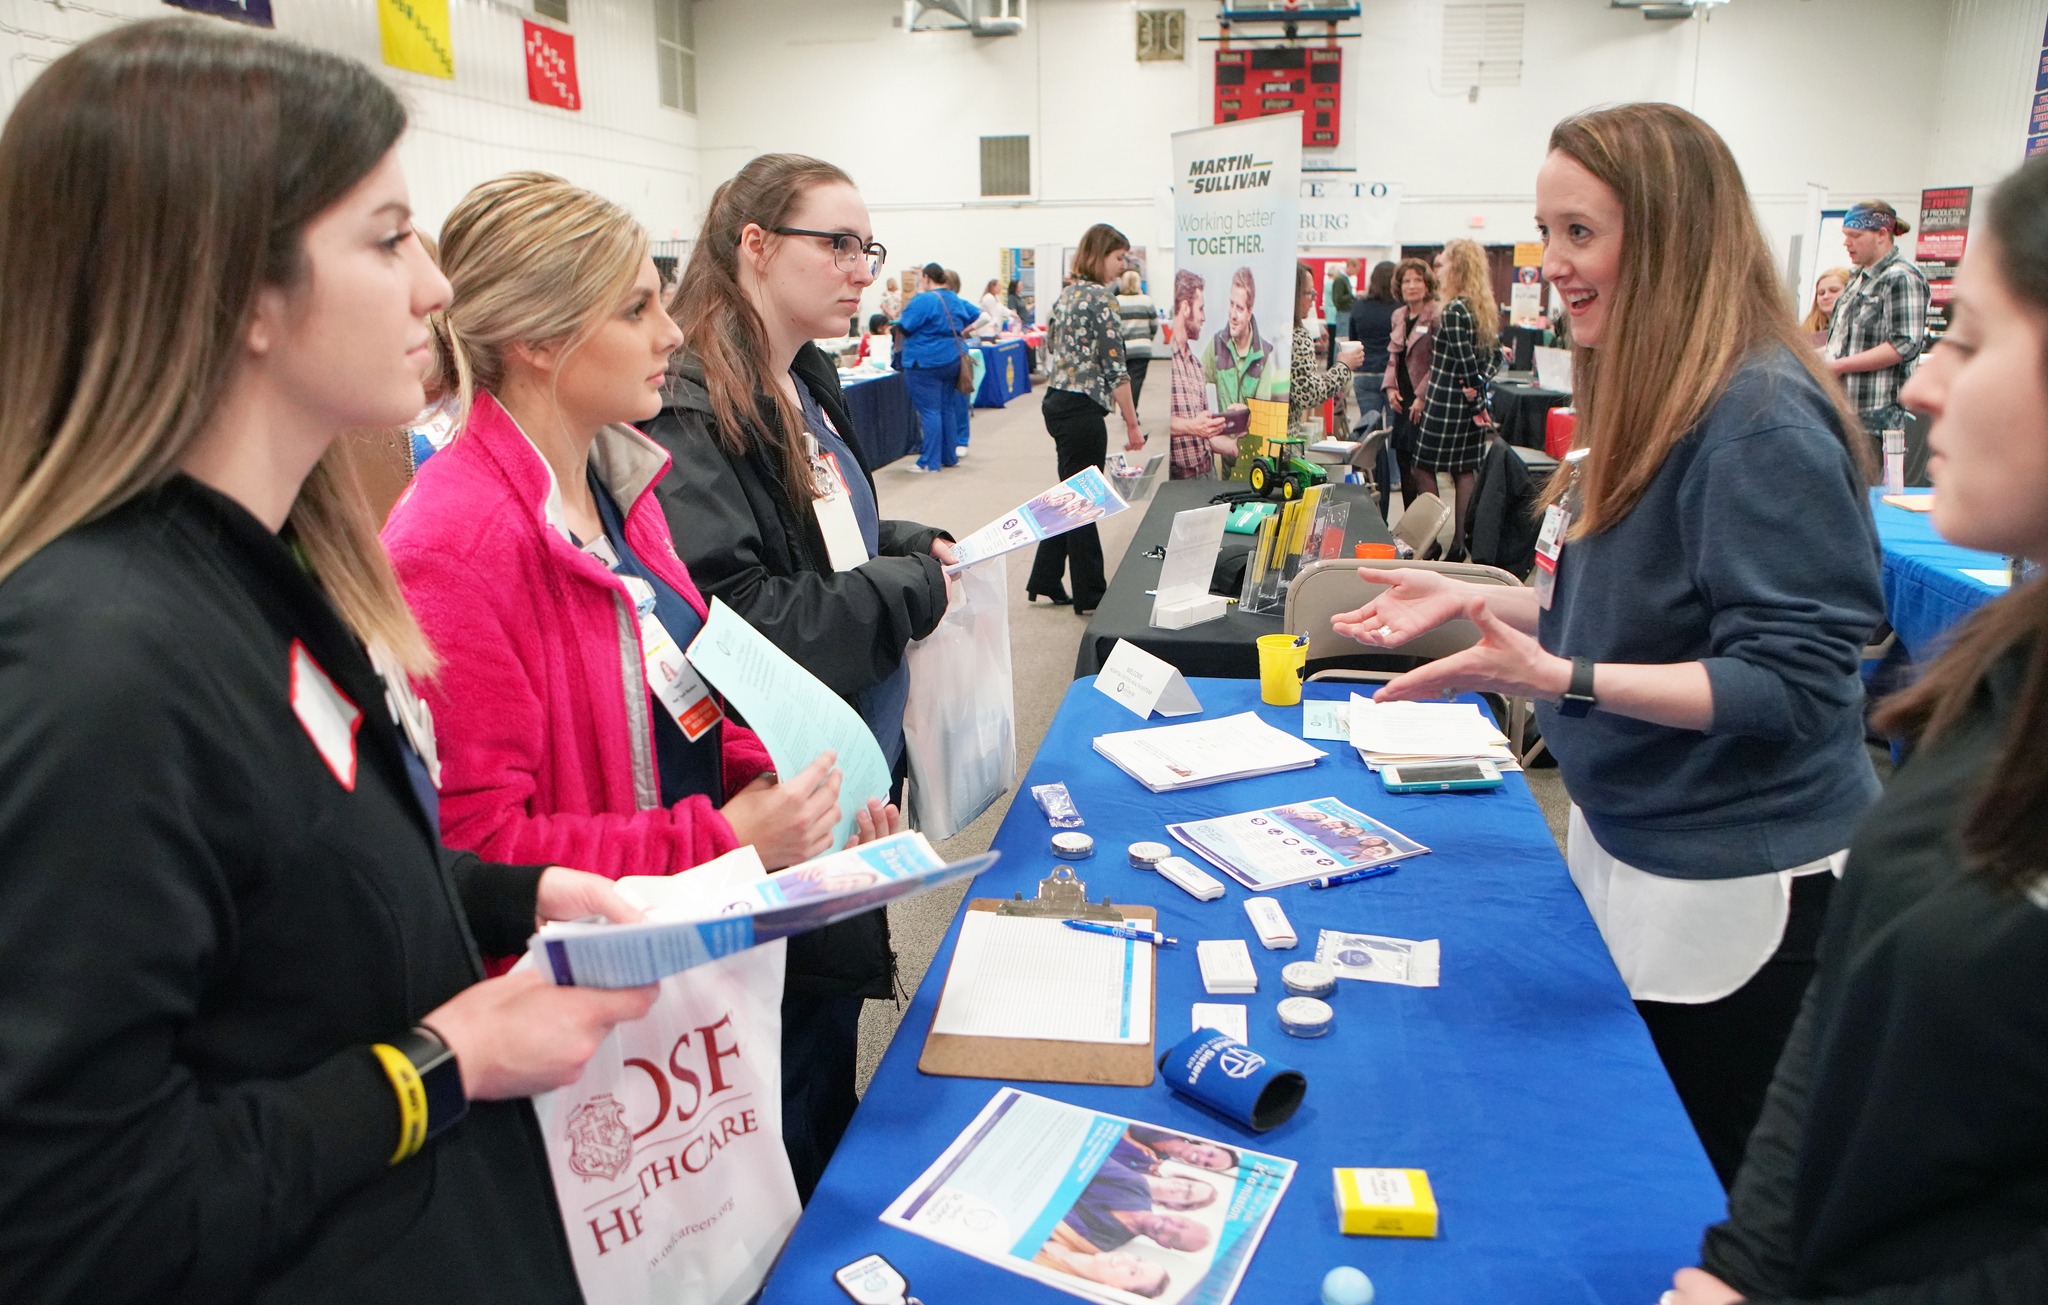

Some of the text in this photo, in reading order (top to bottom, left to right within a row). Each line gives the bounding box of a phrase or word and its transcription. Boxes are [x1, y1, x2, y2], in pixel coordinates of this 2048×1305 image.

[1189, 153, 1254, 177] MARTIN
[1193, 170, 1271, 194] SULLIVAN
[1350, 182, 1388, 198] TO
[1178, 208, 1276, 235] Working better
[1300, 213, 1349, 230] BURG
[1187, 233, 1265, 256] TOGETHER.
[1187, 1048, 1216, 1086] Sisters
